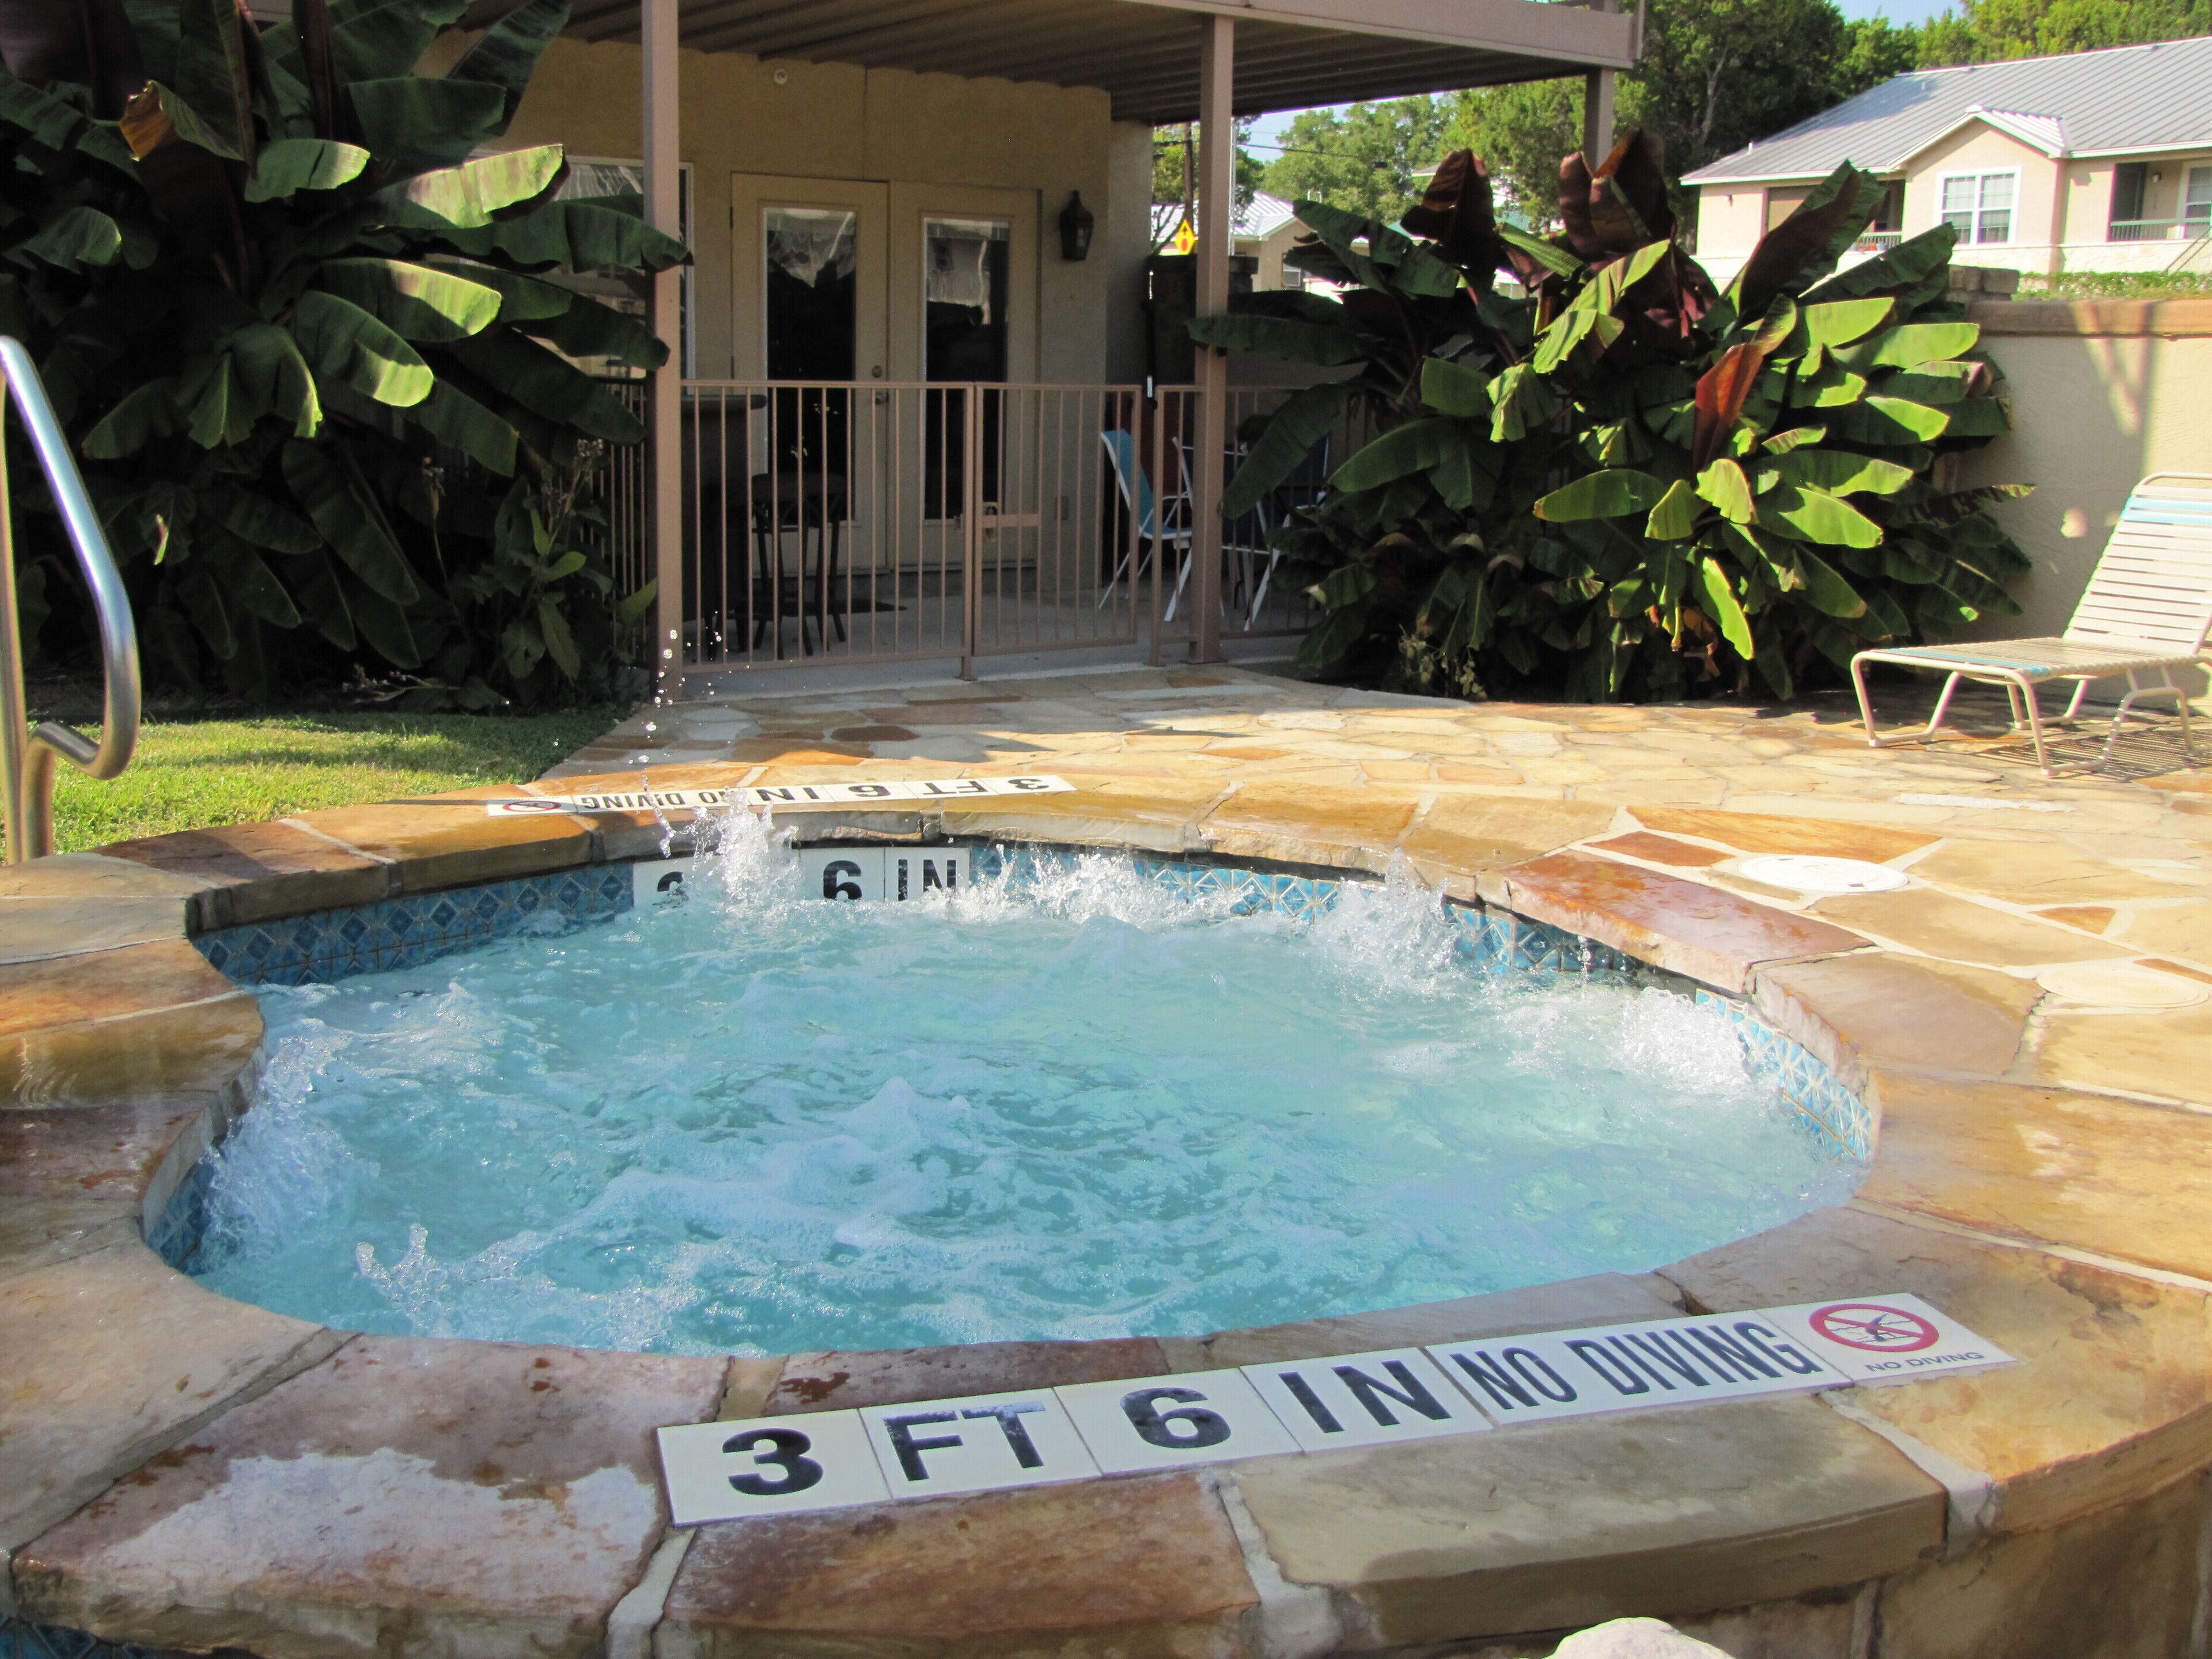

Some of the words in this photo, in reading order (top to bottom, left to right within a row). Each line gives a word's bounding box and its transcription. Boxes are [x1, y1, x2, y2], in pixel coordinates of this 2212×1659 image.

[848, 785, 892, 797] 6
[923, 780, 988, 794] FT
[1007, 778, 1049, 790] 3
[581, 793, 686, 809] DIVING
[756, 787, 820, 801] IN
[823, 859, 862, 900] 6
[897, 858, 957, 901] IN
[1864, 1360, 1902, 1372] NO
[1905, 1351, 1985, 1367] DIVING
[721, 1427, 824, 1495] 3
[882, 1400, 1047, 1482] FT
[1119, 1387, 1232, 1449] 6
[1278, 1359, 1453, 1434] IN
[1449, 1347, 1578, 1410] NO
[1562, 1321, 1825, 1396] DIVING
